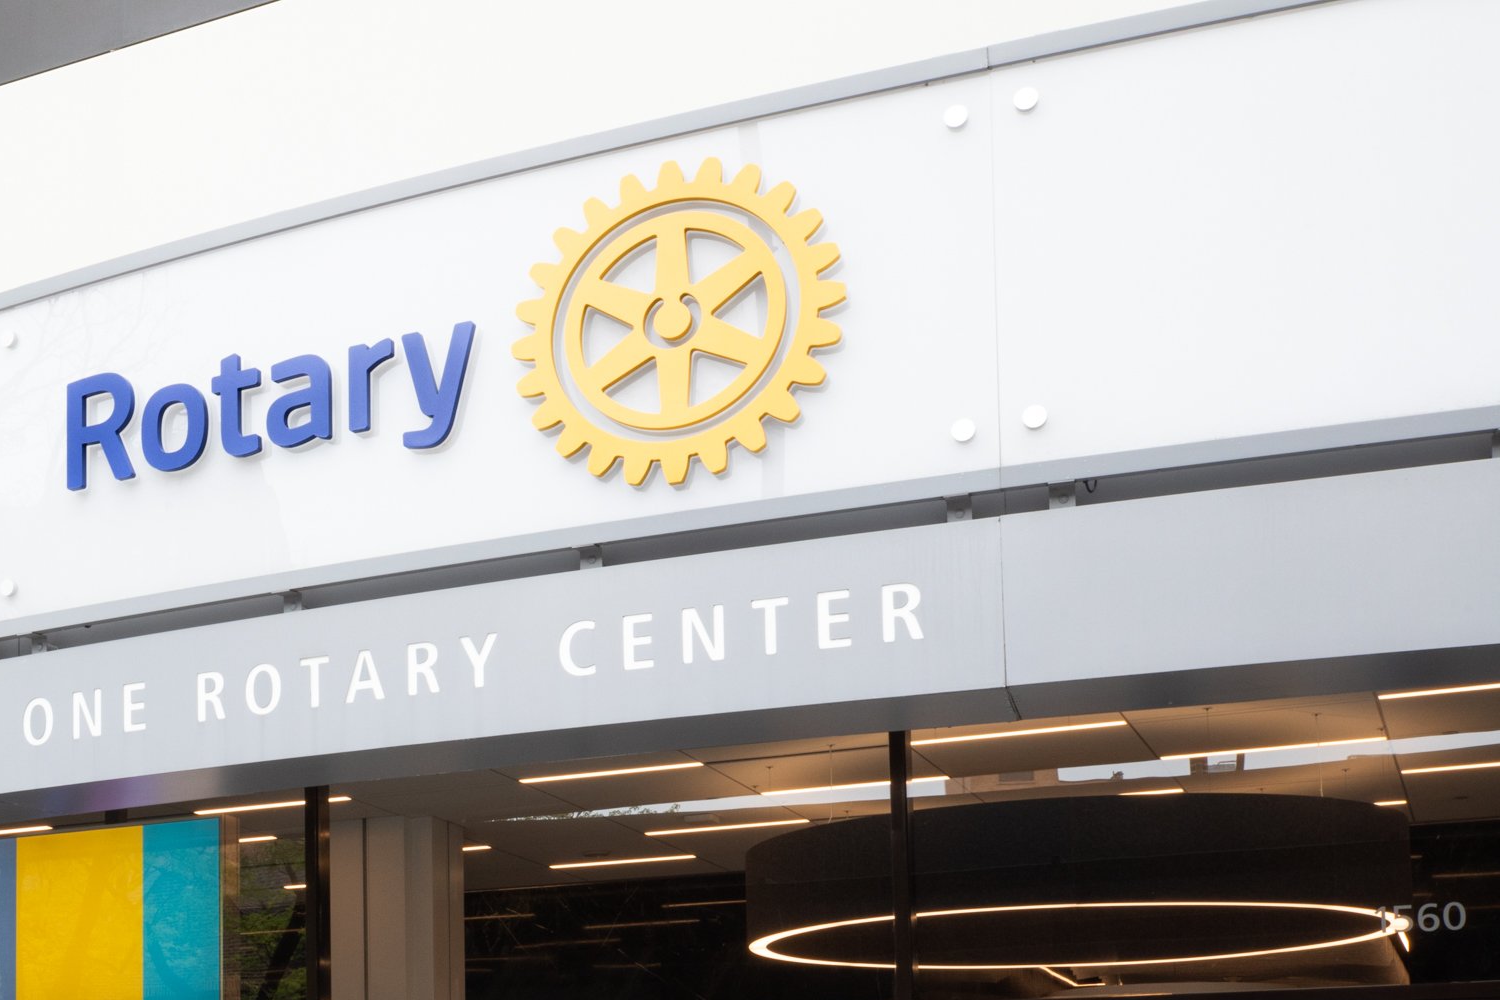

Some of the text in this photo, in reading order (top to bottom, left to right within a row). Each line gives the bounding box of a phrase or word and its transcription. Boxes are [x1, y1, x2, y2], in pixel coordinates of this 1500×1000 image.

[66, 320, 476, 492] Rotary
[22, 582, 925, 747] ONE ROTARY CENTER
[1375, 901, 1467, 933] 1560
